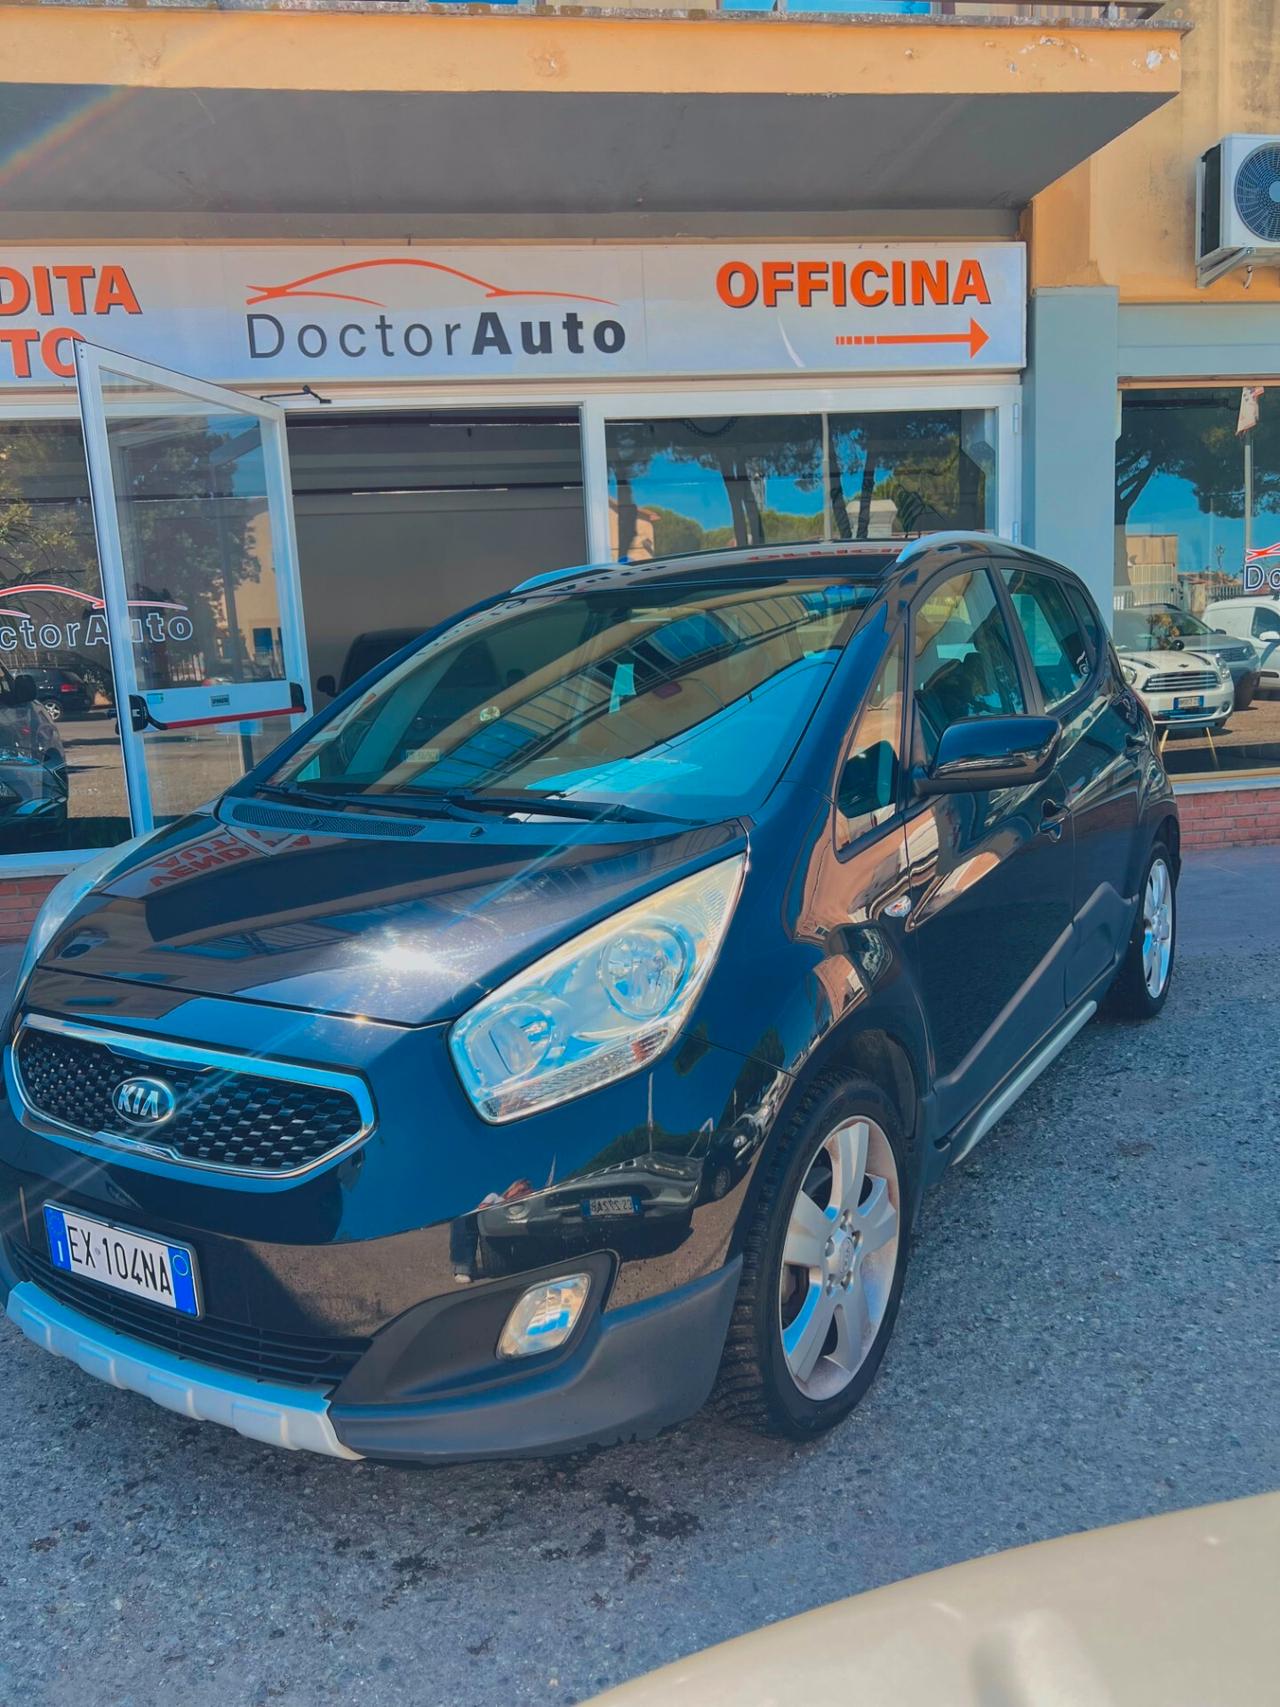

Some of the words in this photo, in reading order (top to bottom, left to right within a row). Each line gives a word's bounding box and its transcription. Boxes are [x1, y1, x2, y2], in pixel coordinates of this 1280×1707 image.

[0, 265, 143, 317] DITA
[715, 259, 991, 309] OFFICINA
[246, 311, 626, 359] DoctorAuto
[118, 1084, 159, 1118] KIA
